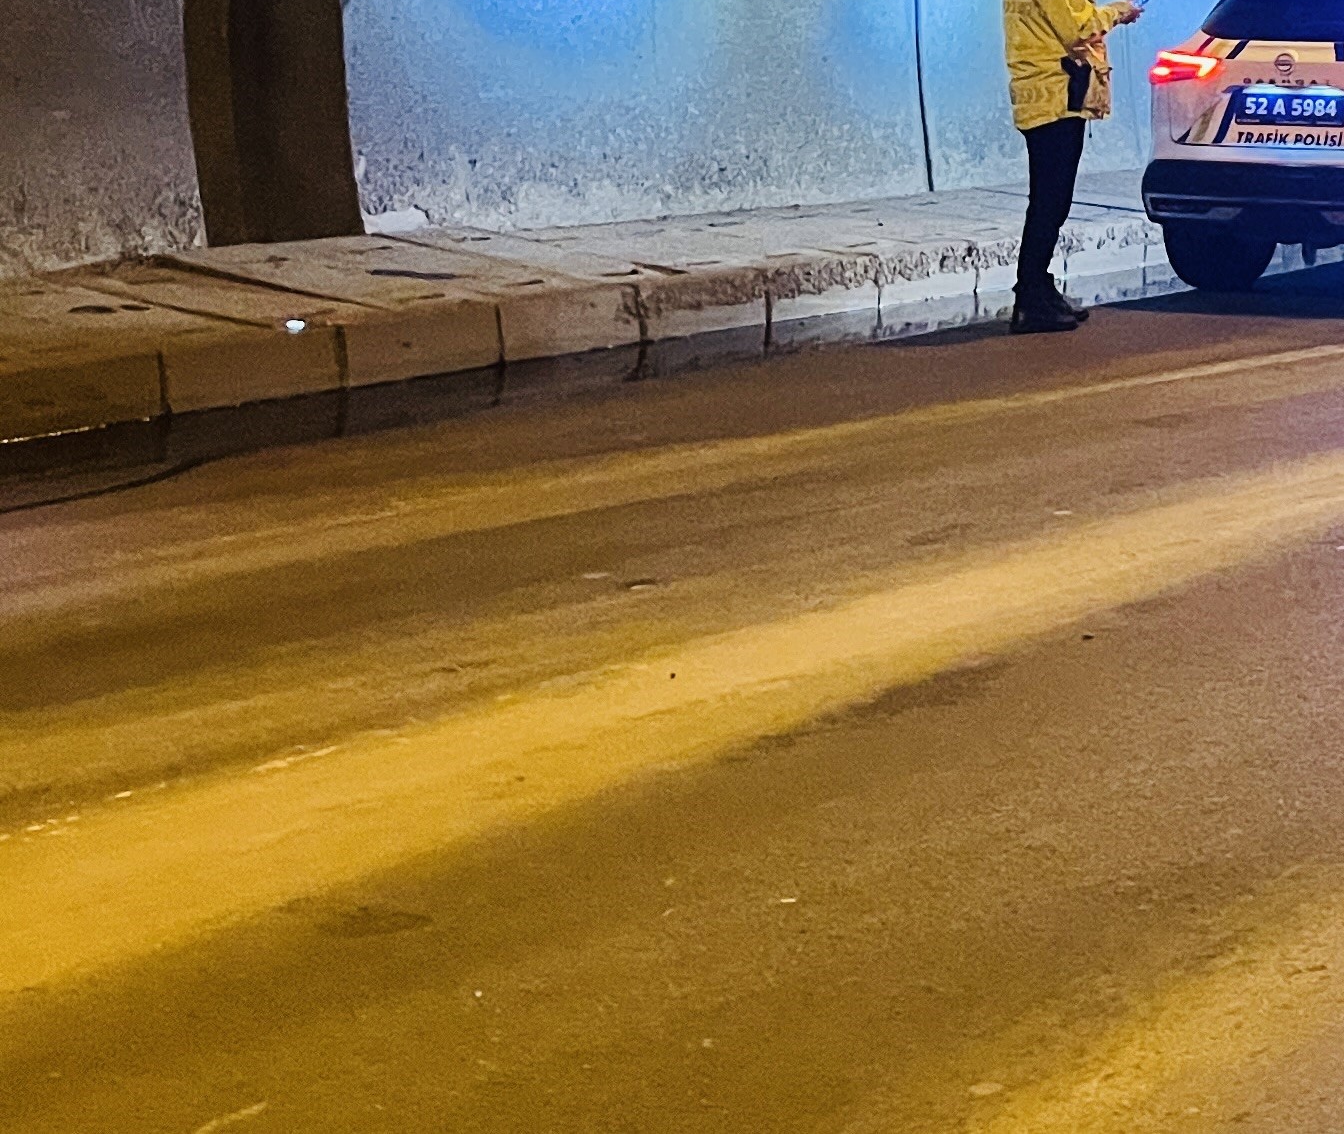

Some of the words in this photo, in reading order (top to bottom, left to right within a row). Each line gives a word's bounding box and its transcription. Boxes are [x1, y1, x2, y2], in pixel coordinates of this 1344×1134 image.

[1245, 97, 1268, 115] 52
[1272, 98, 1286, 116] A
[1291, 99, 1337, 117] 5984
[1237, 129, 1289, 144] TRAFİK
